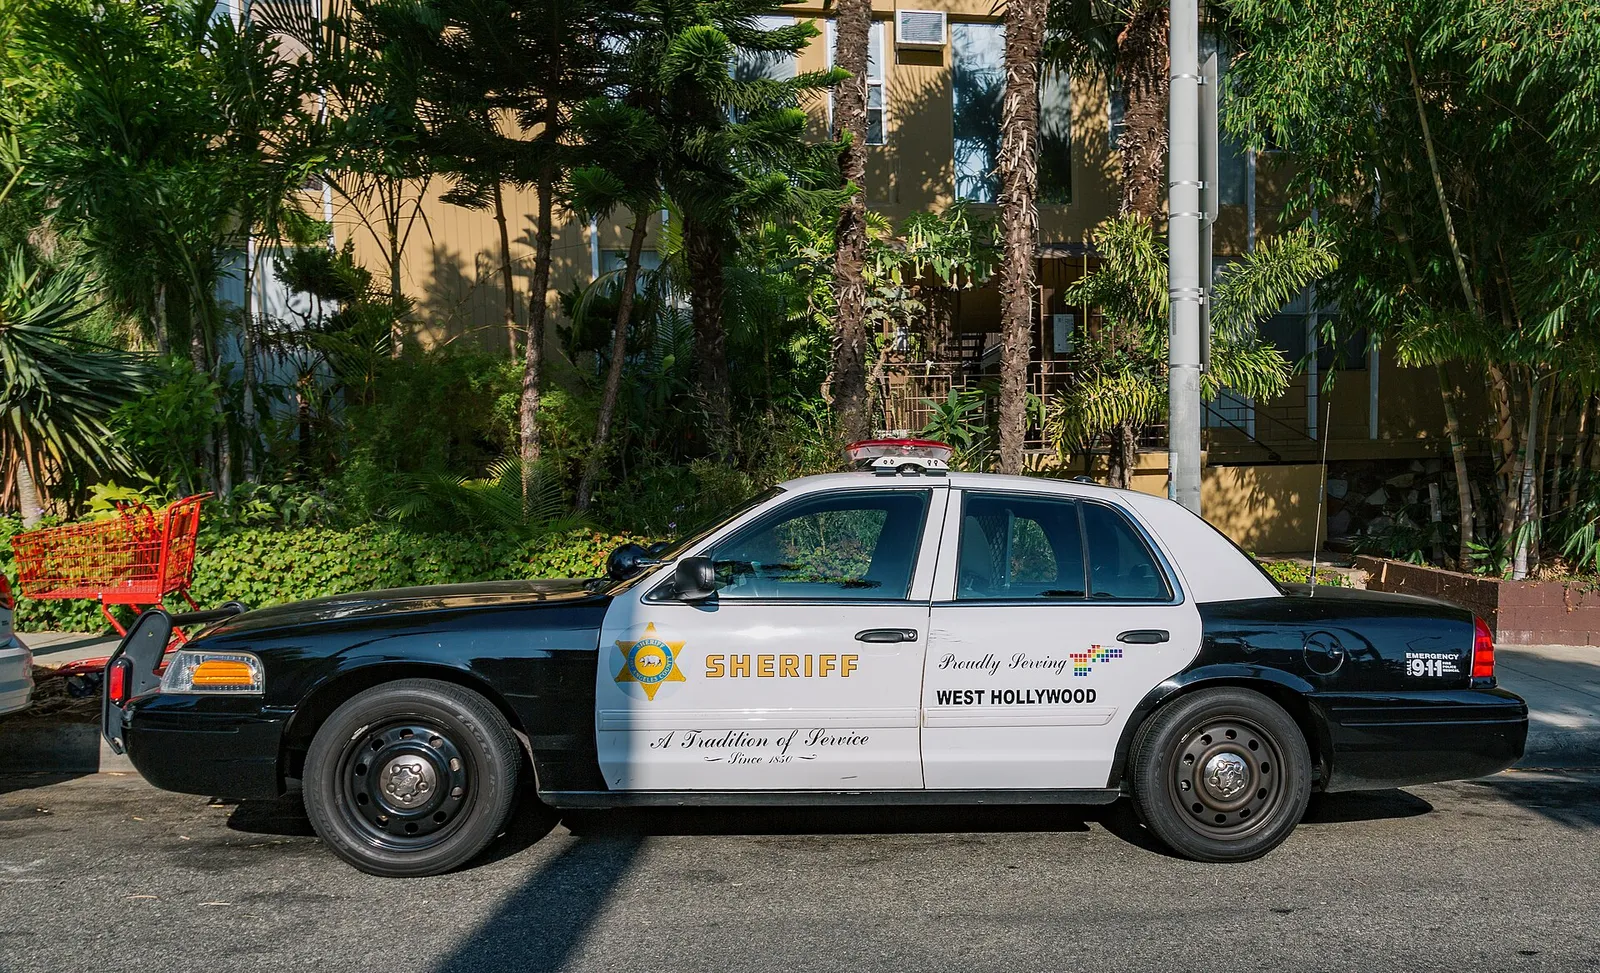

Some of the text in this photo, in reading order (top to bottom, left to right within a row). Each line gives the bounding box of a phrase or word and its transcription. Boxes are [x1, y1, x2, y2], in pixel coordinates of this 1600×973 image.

[705, 654, 859, 678] SHERIFF
[938, 652, 1068, 676] Proudly Serving
[1405, 652, 1459, 660] EMERGENCY
[936, 688, 1097, 705] WEST HOLLYWOOD
[650, 727, 869, 755] A Tradition of Service
[727, 751, 793, 765] Since 1850
